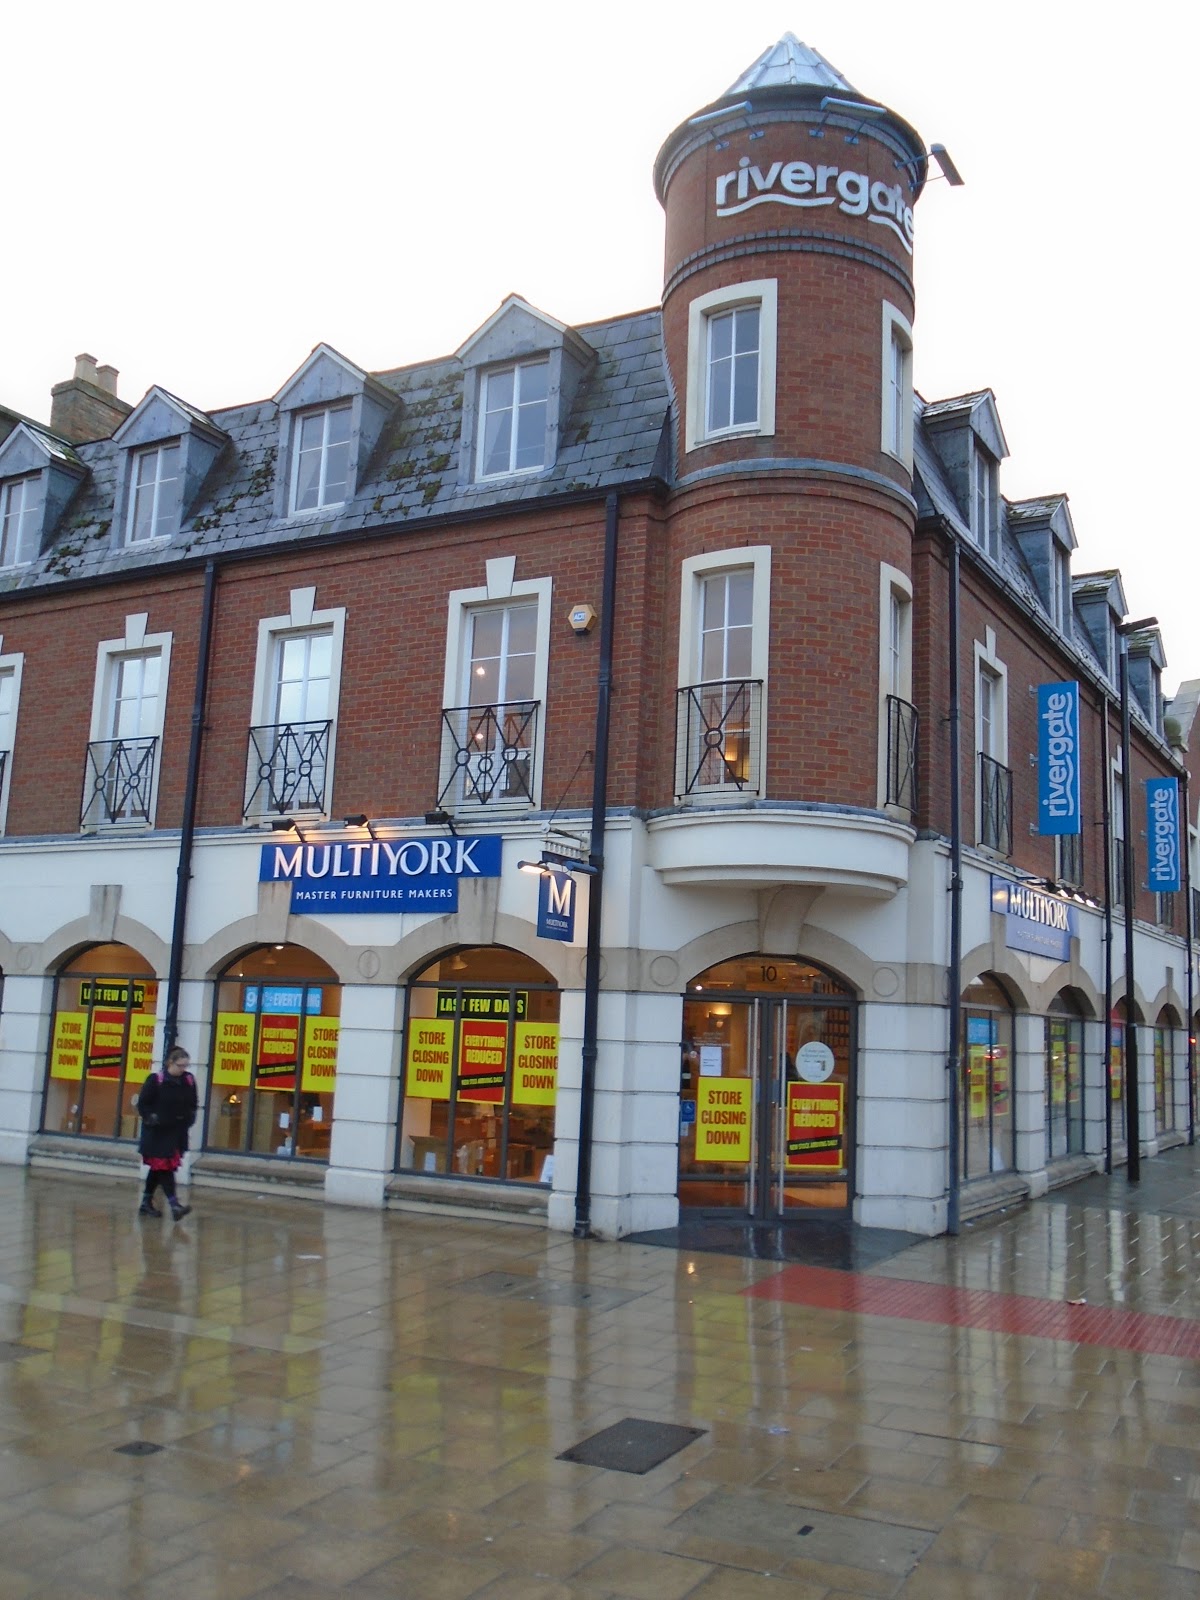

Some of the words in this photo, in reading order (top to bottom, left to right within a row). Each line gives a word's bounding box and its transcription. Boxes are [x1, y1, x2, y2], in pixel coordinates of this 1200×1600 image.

[716, 156, 914, 241] rivergate
[1042, 692, 1073, 817] rivergate
[1151, 788, 1175, 881] rivergate
[273, 839, 481, 879] MULTIYORK
[296, 890, 337, 900] MASTER
[341, 889, 404, 899] FURNITURE
[408, 888, 453, 898] MAKERS
[547, 875, 572, 917] M
[1010, 884, 1071, 932] MULTIYORK
[761, 965, 777, 982] 10
[104, 989, 119, 1001] FEW
[121, 990, 143, 1003] DYS
[469, 998, 491, 1012] FEW
[494, 999, 524, 1014] DAS
[61, 1022, 81, 1034] STORE
[137, 1025, 155, 1037] STOR
[223, 1024, 248, 1036] STORE
[313, 1028, 339, 1041] STORE
[56, 1038, 83, 1050] CLOSING
[418, 1031, 446, 1045] STORE
[464, 1034, 506, 1049] EVERYTHING
[524, 1035, 556, 1049] STORE
[218, 1041, 250, 1054] CLOSING
[308, 1046, 337, 1060] CLOSIN
[58, 1054, 78, 1066] DOWN
[412, 1050, 449, 1064] CLOSING
[465, 1050, 503, 1065] REDUCED
[221, 1058, 245, 1071] DOWN
[416, 1069, 443, 1083] DOWN
[522, 1074, 554, 1089] DOWN
[708, 1090, 742, 1105] STORE
[792, 1098, 839, 1111] EVERYTHING
[701, 1110, 747, 1125] CLOSING
[793, 1113, 836, 1128] REDUCED
[706, 1130, 741, 1145] DOWN
